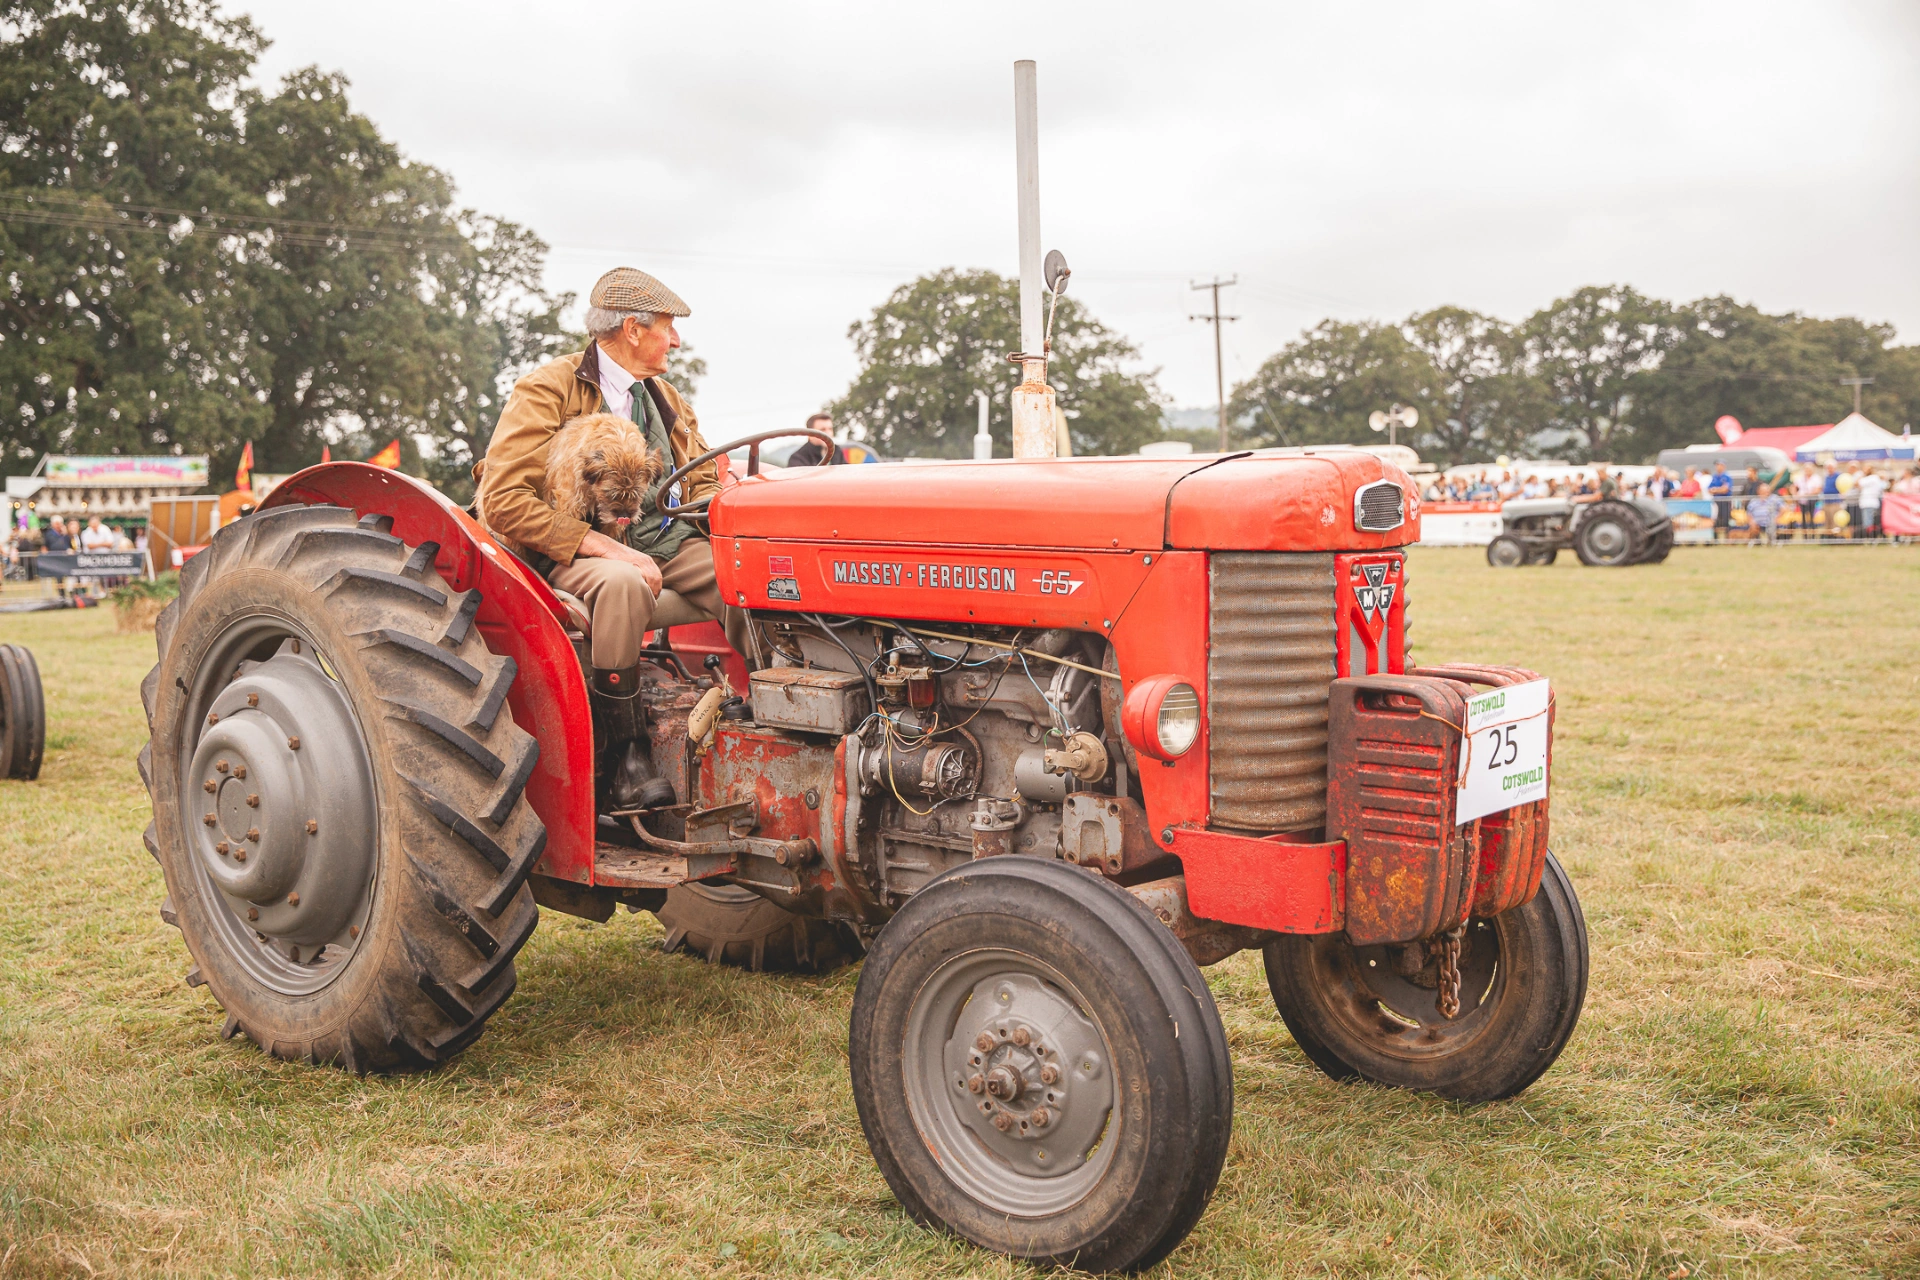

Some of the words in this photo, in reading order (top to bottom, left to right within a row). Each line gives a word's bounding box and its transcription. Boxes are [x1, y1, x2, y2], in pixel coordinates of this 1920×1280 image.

[834, 560, 902, 586] MASSEY
[918, 564, 1016, 592] FERGUSON
[1040, 570, 1071, 595] 65
[1470, 692, 1505, 717] COTSWOLD
[1488, 724, 1518, 770] 25
[1503, 766, 1544, 790] COTSWOLD
